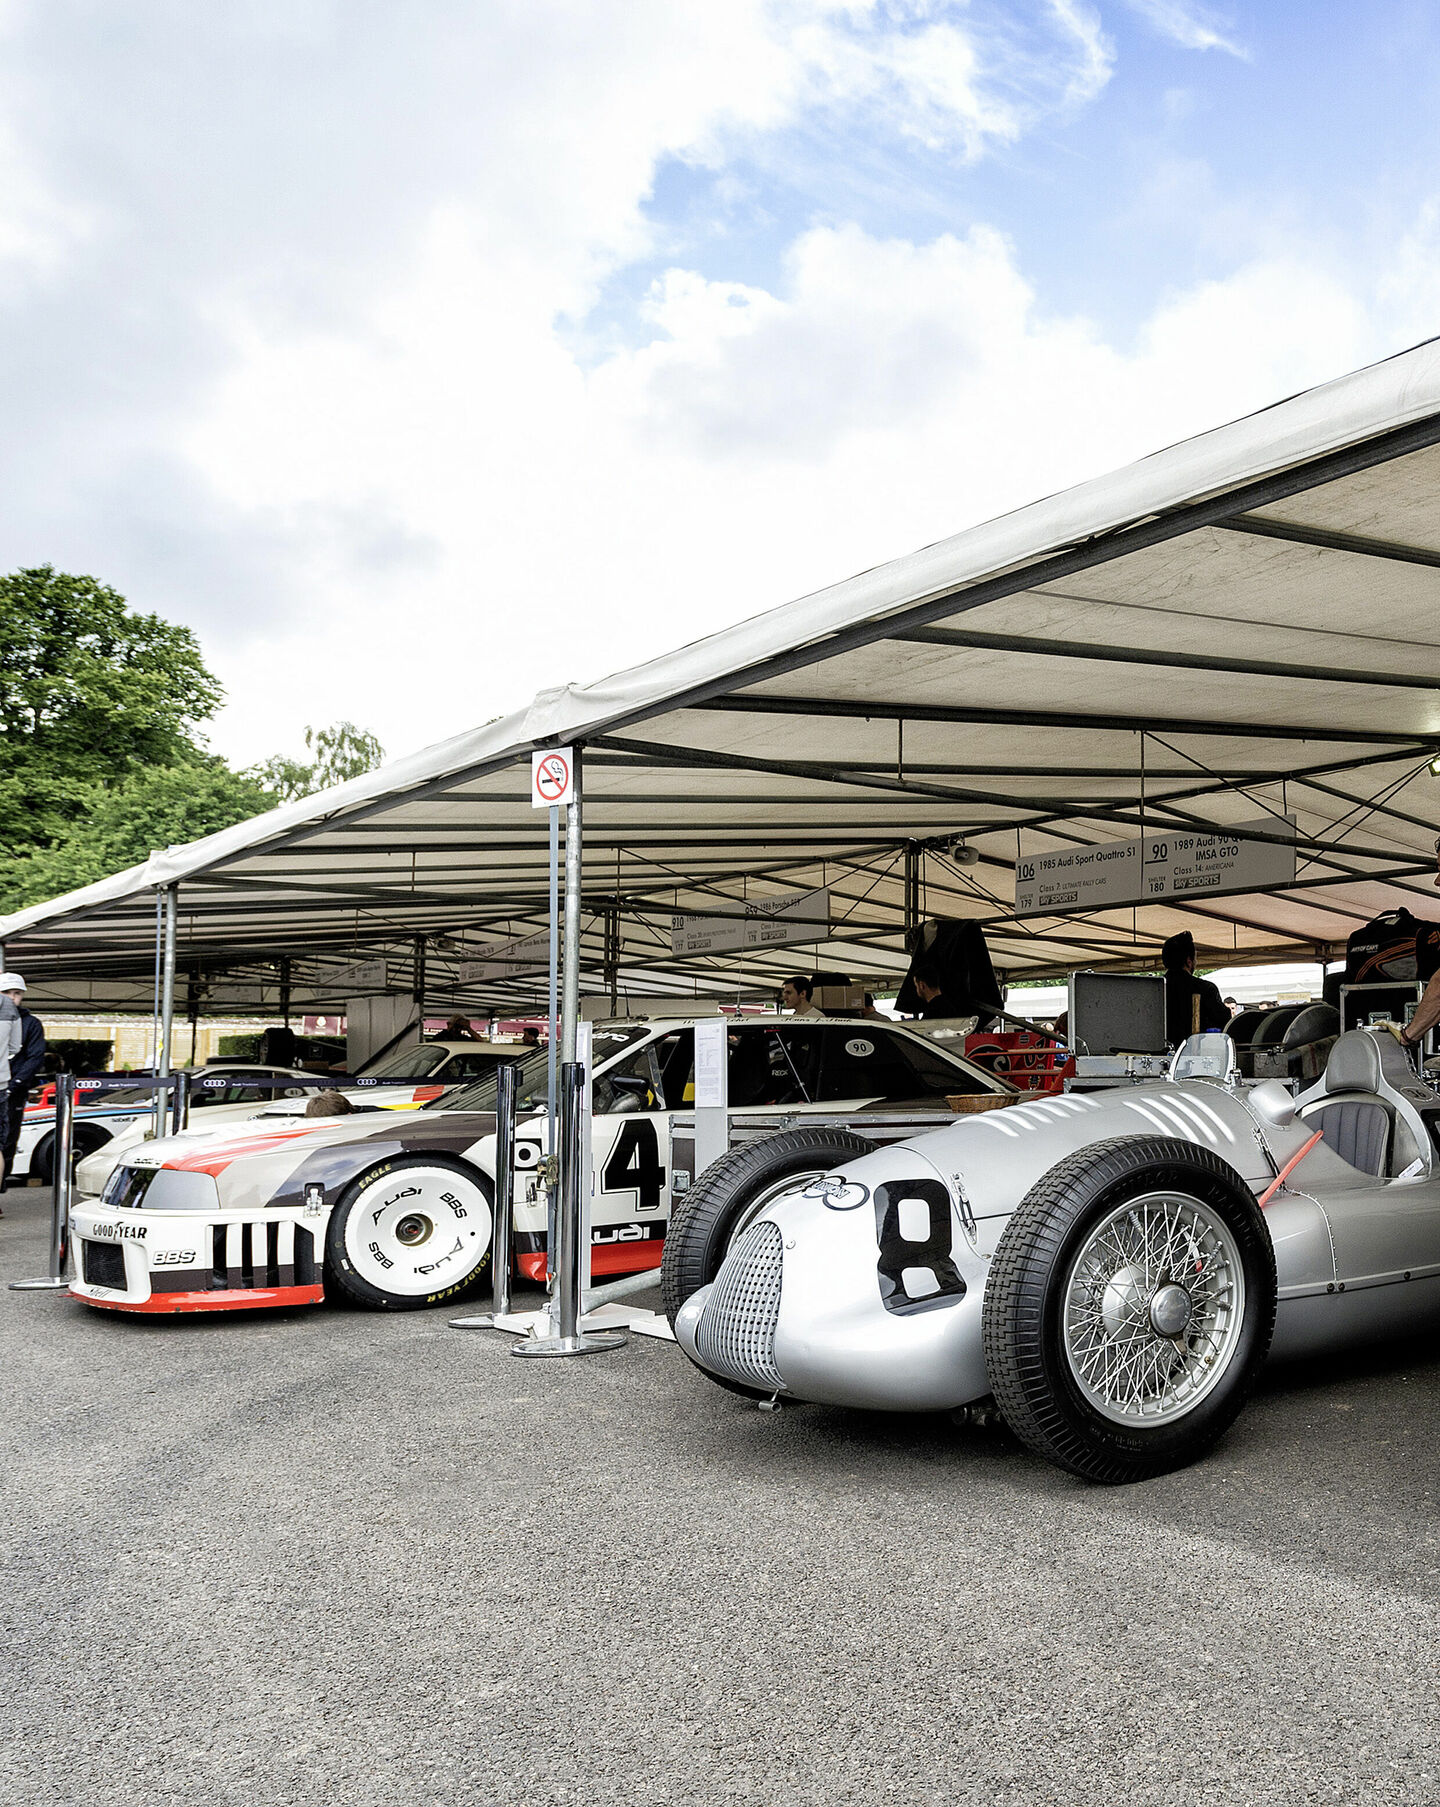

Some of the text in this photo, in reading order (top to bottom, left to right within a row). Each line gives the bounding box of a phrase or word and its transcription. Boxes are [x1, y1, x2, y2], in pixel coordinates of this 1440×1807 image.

[1152, 843, 1168, 860] 90
[1174, 838, 1194, 851] 1989
[1196, 836, 1216, 848] Audi
[1039, 847, 1136, 871] 1985 Audi Sport Quattro S1
[1195, 845, 1239, 861] IMSA GTO
[1017, 863, 1035, 879] 106
[1173, 867, 1192, 876] Class
[1204, 861, 1234, 871] AMERICANA
[1039, 884, 1055, 893] Class
[1095, 877, 1107, 885] CARS
[1150, 882, 1164, 893] 180
[1188, 875, 1219, 888] SPORTS
[1020, 899, 1032, 908] 179
[1051, 892, 1077, 903] SPORTS
[672, 916, 684, 928] 910
[852, 1043, 867, 1053] 90
[600, 1117, 667, 1212] 4
[358, 1163, 393, 1190] EAGLE
[371, 1187, 423, 1227] Audi
[439, 1191, 468, 1219] BBS
[92, 1221, 148, 1241] GOODYEAR
[591, 1223, 650, 1244] udi
[368, 1241, 395, 1270] BBS
[413, 1236, 465, 1275] Audi
[872, 1178, 968, 1318] 8
[152, 1249, 197, 1266] BBS
